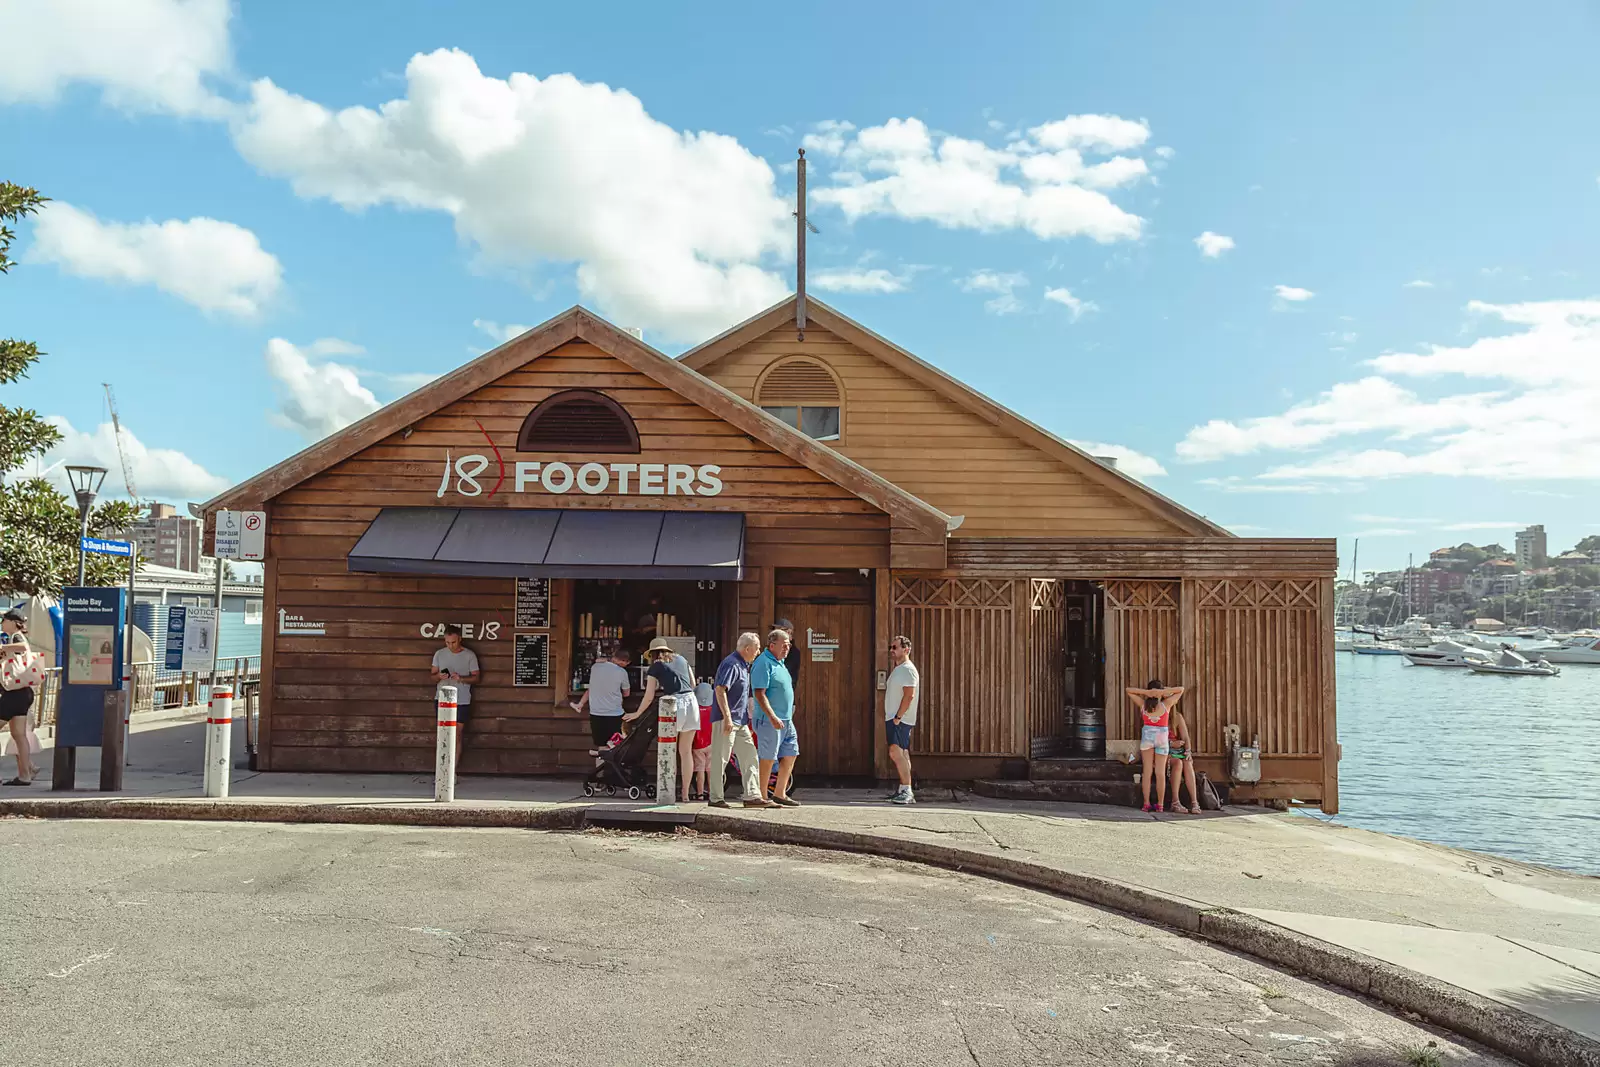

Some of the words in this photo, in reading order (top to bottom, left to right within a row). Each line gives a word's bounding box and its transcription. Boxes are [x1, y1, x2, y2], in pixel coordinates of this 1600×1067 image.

[515, 461, 723, 497] FOOTERS
[67, 598, 88, 606] Double
[90, 598, 102, 606] Bay
[420, 622, 475, 638] CAE
